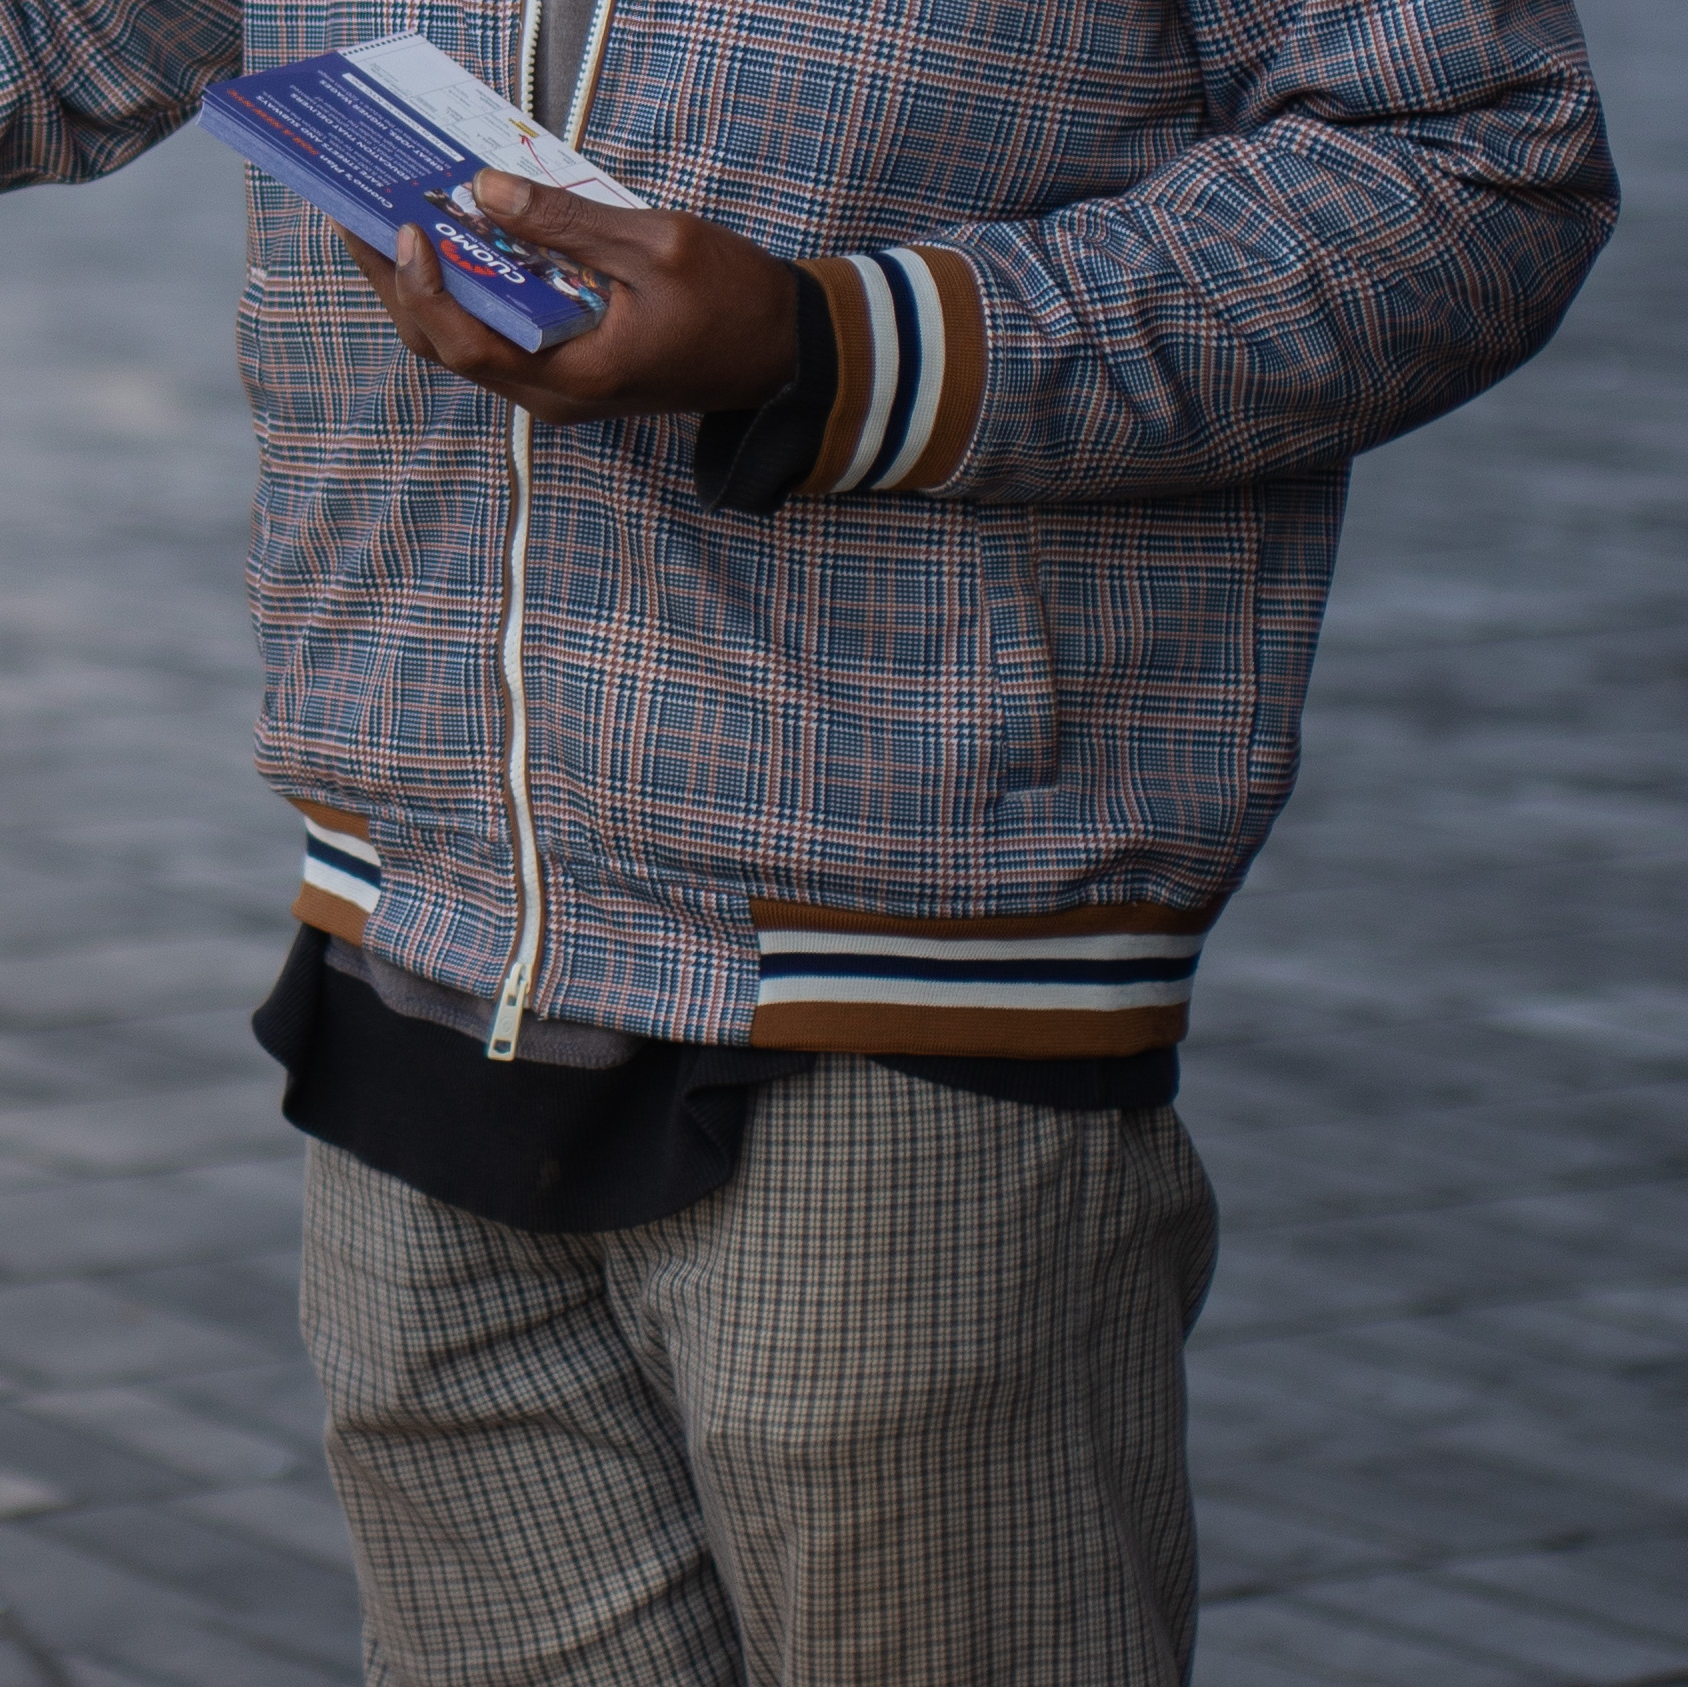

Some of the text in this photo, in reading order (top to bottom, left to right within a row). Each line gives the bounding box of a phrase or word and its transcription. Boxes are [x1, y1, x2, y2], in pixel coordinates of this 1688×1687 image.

[317, 79, 354, 104] WAGES
[350, 104, 389, 129] HIGHER
[252, 95, 386, 187] SAFE STREETS AND SUBWAYS
[288, 93, 411, 180] EDUCATION THAT DELIVERS
[315, 154, 346, 173] Plan
[412, 148, 445, 171] GREAT
[341, 172, 395, 208] Cuomo's
[432, 219, 527, 286] CUOMO
